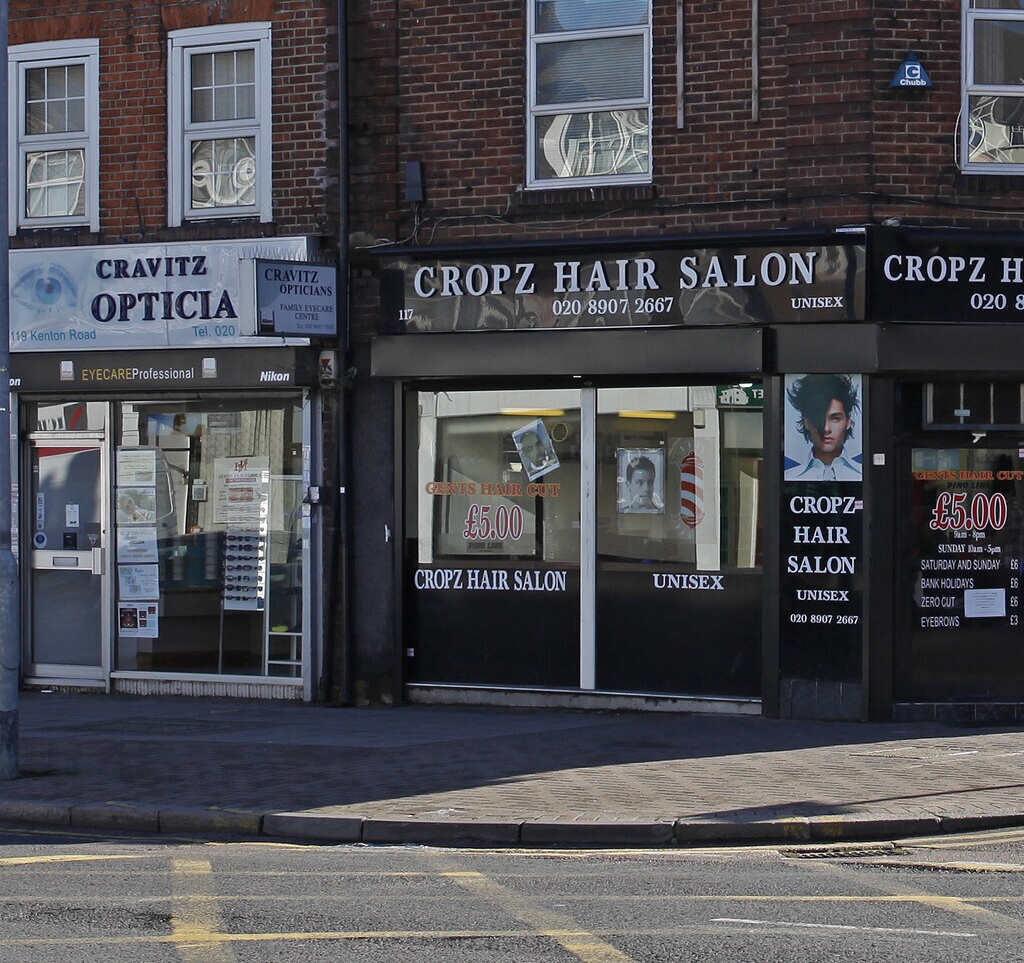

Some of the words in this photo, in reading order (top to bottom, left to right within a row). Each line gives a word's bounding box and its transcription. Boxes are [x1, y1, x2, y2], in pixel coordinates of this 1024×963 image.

[95, 255, 207, 280] CRAVITZ
[414, 263, 535, 298] CROPZ
[553, 258, 659, 293] HAIR
[680, 251, 816, 289] SALON
[883, 254, 986, 282] CROPZ
[265, 268, 319, 283] CRAVITZ
[280, 284, 333, 297] OPTICIANS
[91, 290, 238, 322] OPTICIA
[305, 304, 334, 313] EYECARE
[552, 300, 581, 316] 020
[588, 298, 629, 315] 8907
[635, 297, 674, 314] 2667
[791, 296, 844, 310] UNISEX
[970, 293, 1007, 310] 020
[399, 309, 414, 321] 117
[11, 331, 27, 342] 119
[31, 329, 66, 341] Kenton
[69, 328, 97, 340] Road
[192, 326, 212, 337] Tel.
[215, 325, 236, 337] 020
[259, 370, 290, 382] Nikon
[914, 470, 957, 480] GENTS
[960, 470, 994, 480] HAIR
[997, 470, 1024, 480] CUT
[425, 481, 476, 495] GENTS
[480, 482, 522, 496] HAIR
[526, 483, 560, 497] CUT
[790, 496, 855, 514] CROPZ
[929, 491, 1007, 531] £5.00
[463, 503, 524, 541] £5.00
[793, 526, 850, 544] HAIR
[938, 544, 966, 553] SUNDAY
[787, 556, 856, 574] SALON
[921, 559, 956, 571] SATURDAY
[957, 559, 972, 570] AND
[973, 559, 1000, 570] SUNDAY
[1010, 559, 1019, 570] £6
[414, 569, 463, 590] CROPZ
[467, 569, 510, 590] HAIR
[514, 570, 567, 591] SALON
[653, 574, 724, 590] UNISEX
[921, 578, 940, 589] BANK
[941, 578, 974, 589] HOLIDAYS
[1010, 578, 1019, 589] £6
[796, 589, 849, 602] UNISEX
[921, 596, 940, 608] ZERO
[941, 596, 955, 608] CUT
[1010, 596, 1019, 607] £6
[790, 613, 807, 623] 020
[810, 614, 833, 624] 8907
[836, 615, 859, 625] 2667
[921, 616, 960, 627] EYEBROWS
[1010, 615, 1019, 626] £3
